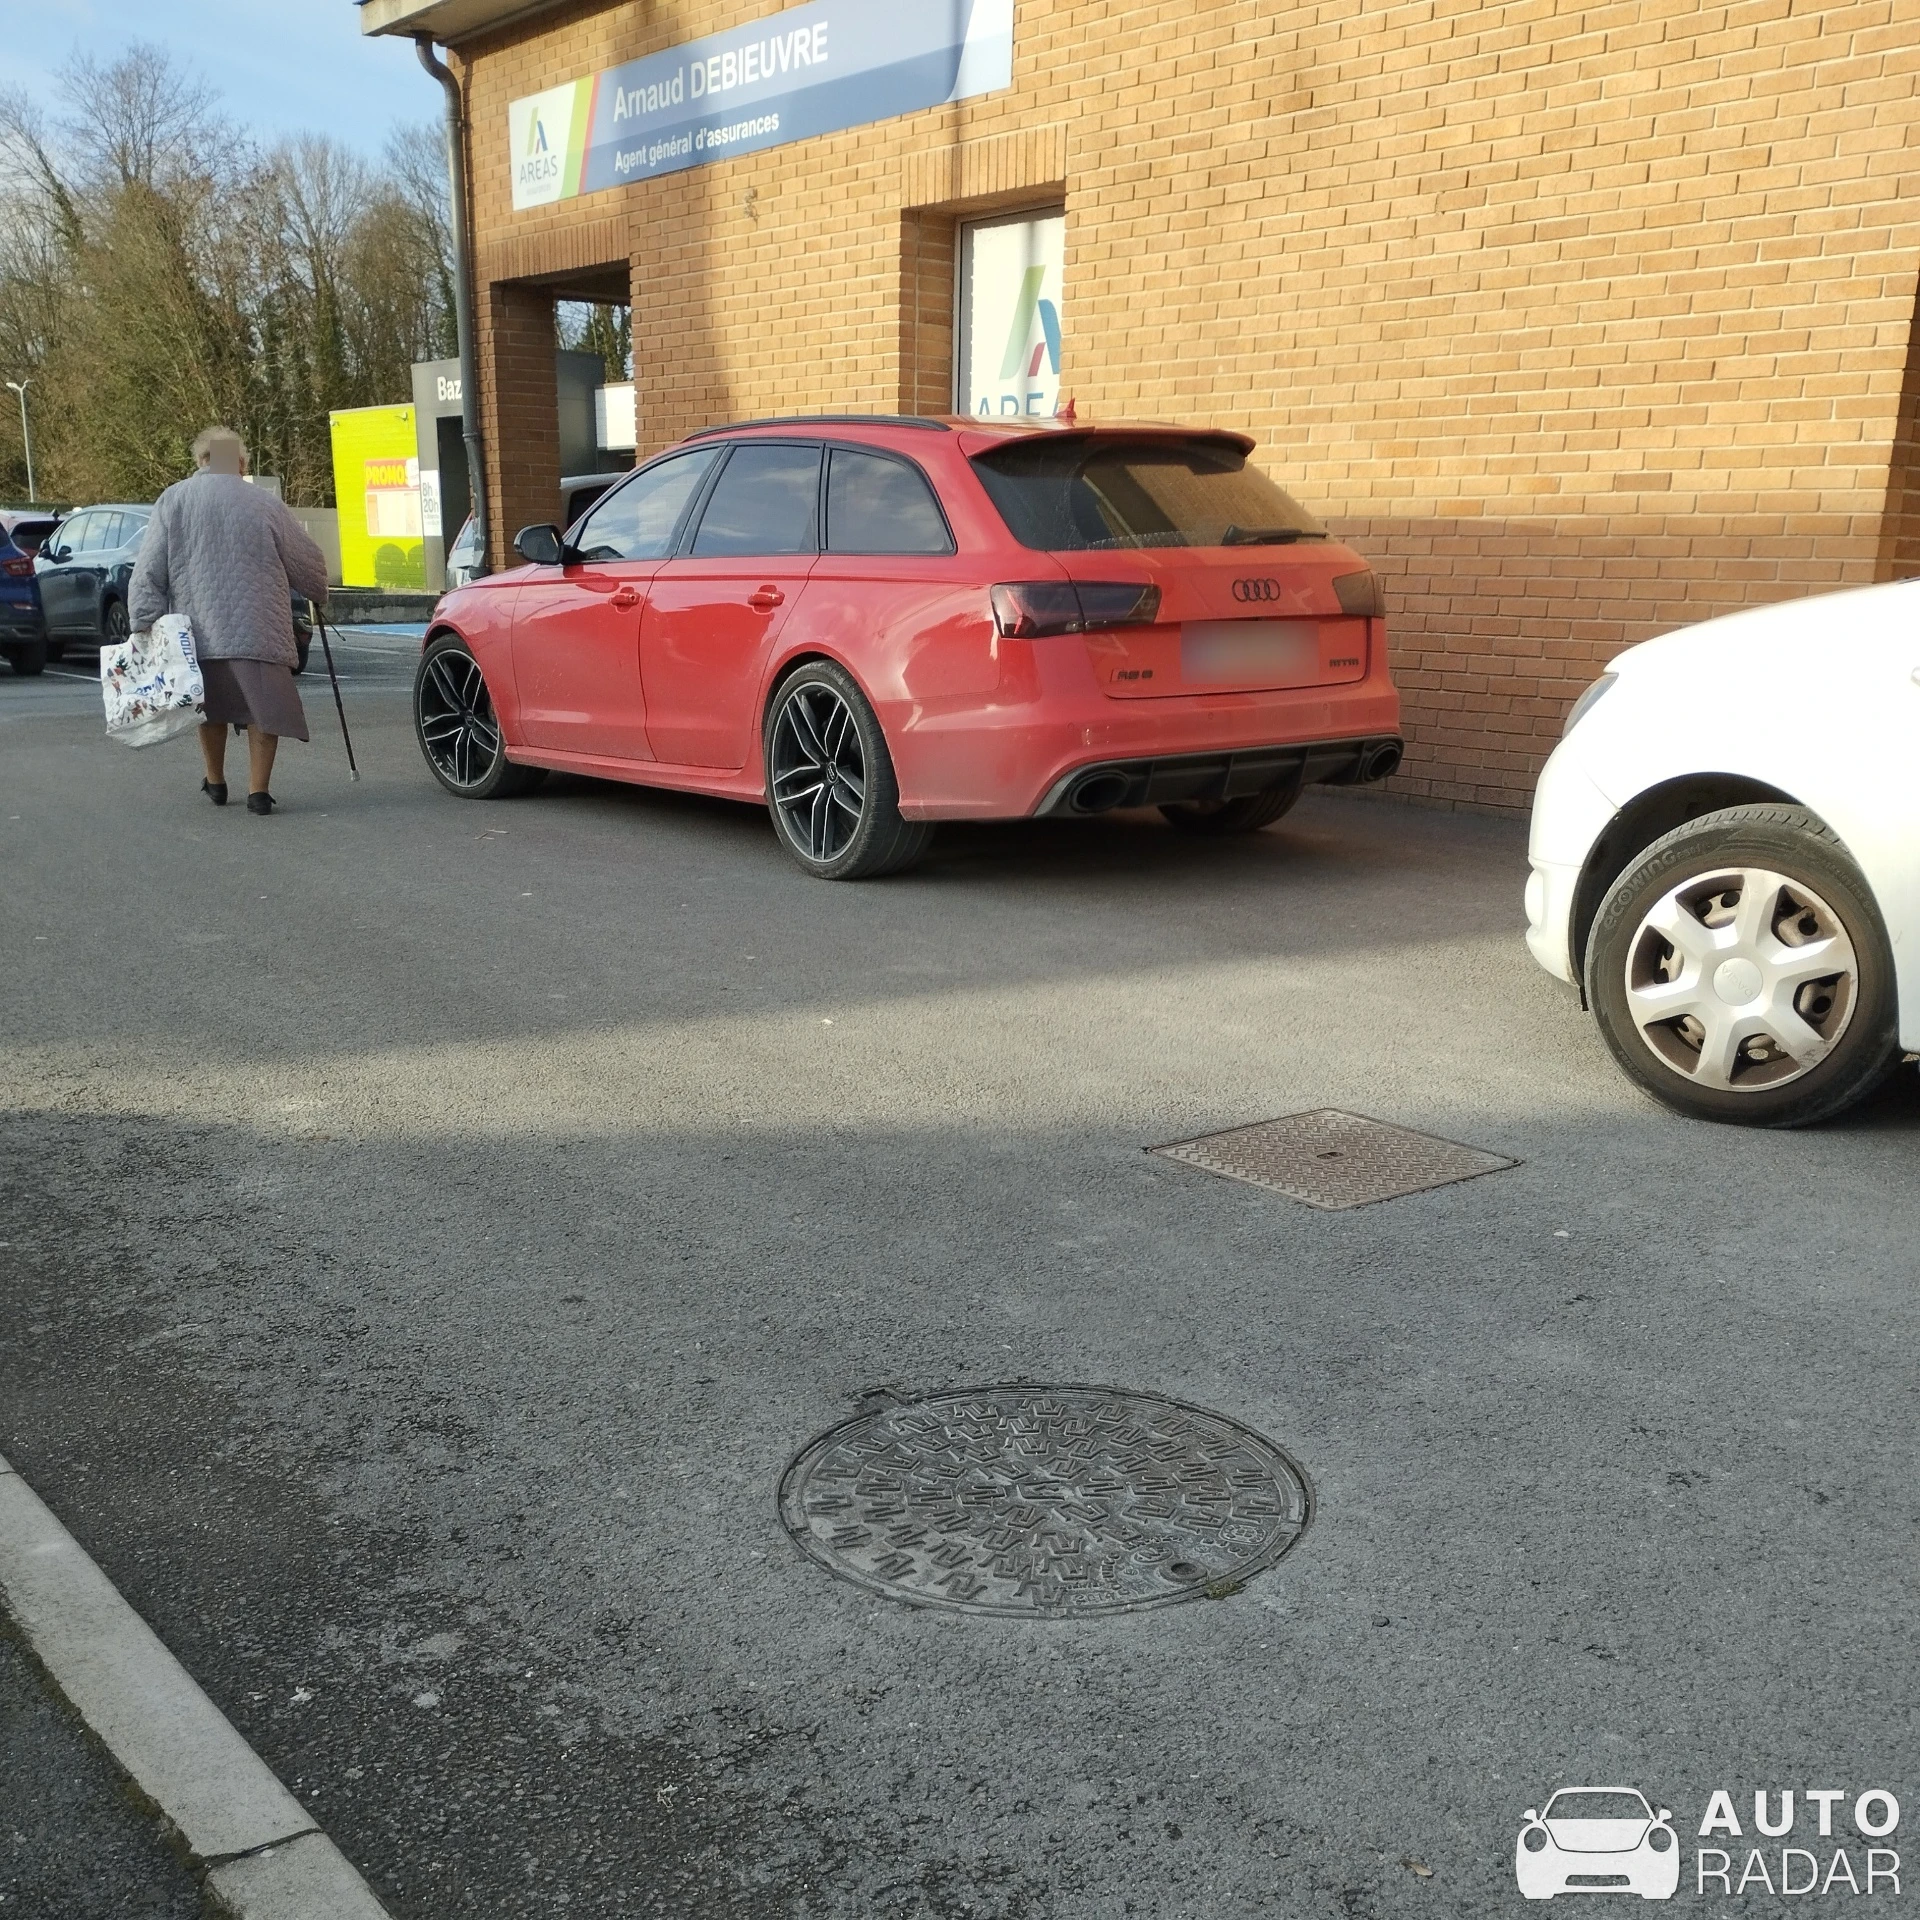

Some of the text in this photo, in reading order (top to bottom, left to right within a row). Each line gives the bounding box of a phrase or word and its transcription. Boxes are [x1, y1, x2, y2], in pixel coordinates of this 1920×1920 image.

[613, 21, 829, 122] Arnaud DEBIEUVRE
[614, 112, 780, 174] Agent général d'assurances
[519, 154, 558, 185] AREAS
[423, 498, 440, 514] 20h
[178, 631, 199, 674] ACTION
